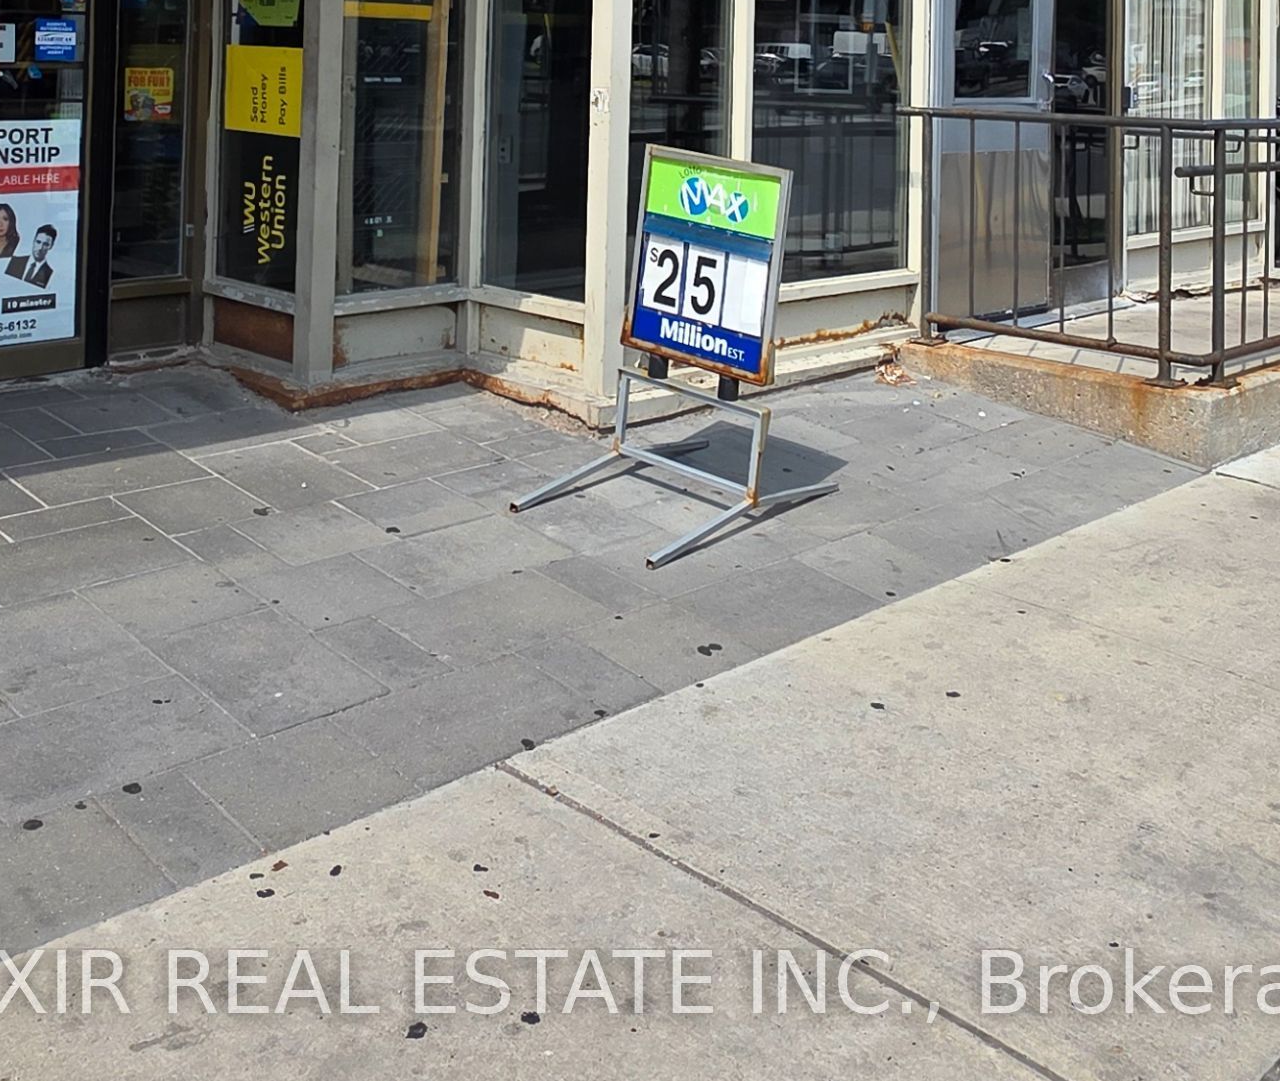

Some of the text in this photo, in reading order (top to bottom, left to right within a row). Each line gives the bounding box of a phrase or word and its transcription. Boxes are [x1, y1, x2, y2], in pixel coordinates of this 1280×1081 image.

[249, 86, 258, 123] Send
[259, 73, 269, 124] Money
[278, 65, 288, 126] Pay Bills
[32, 172, 60, 184] HERE
[681, 177, 747, 222] MAX
[243, 181, 256, 228] WU
[258, 155, 273, 264] Western
[271, 174, 286, 250] Union
[7, 298, 52, 309] 10 minutes
[659, 318, 728, 357] Million
